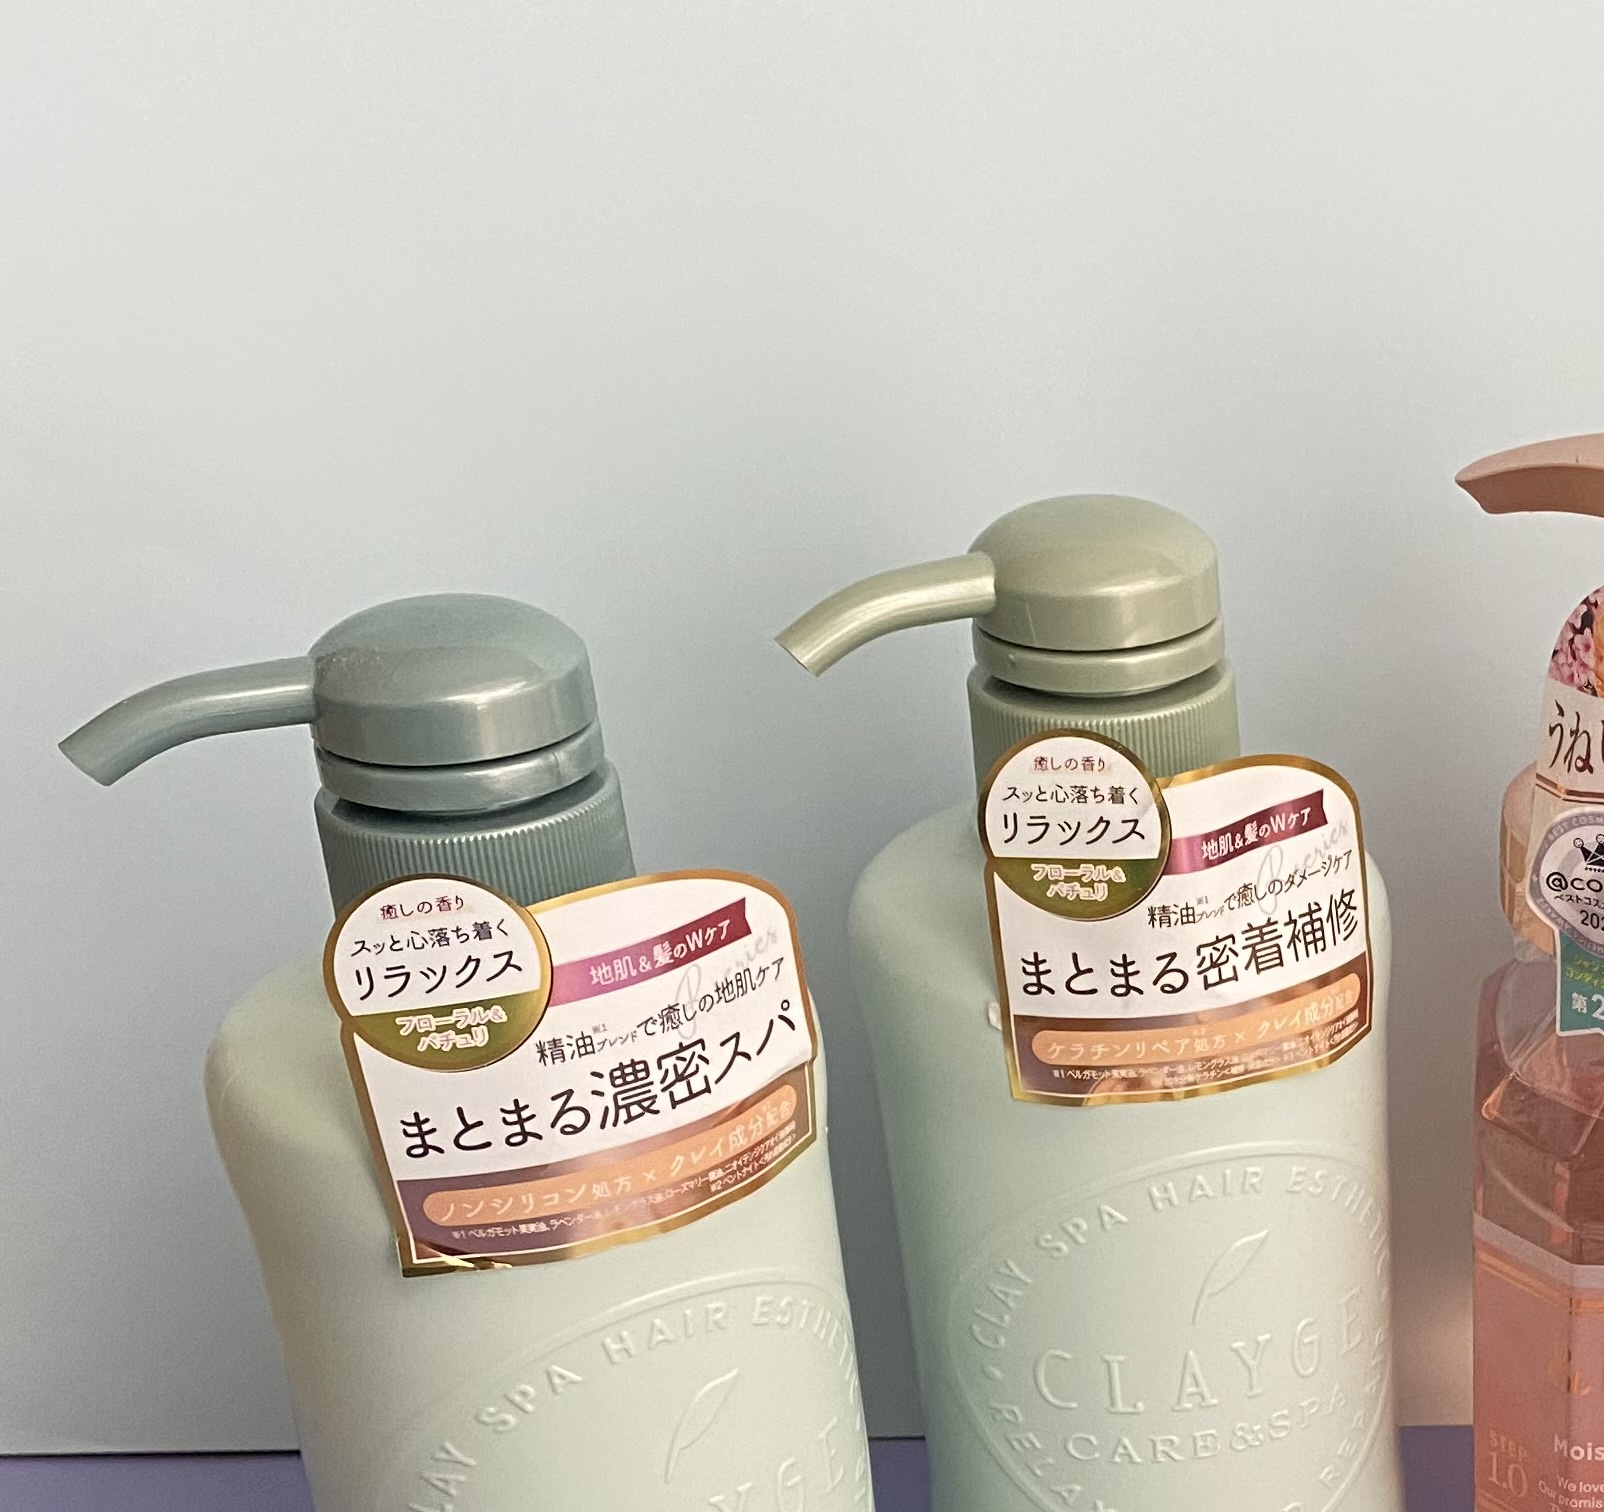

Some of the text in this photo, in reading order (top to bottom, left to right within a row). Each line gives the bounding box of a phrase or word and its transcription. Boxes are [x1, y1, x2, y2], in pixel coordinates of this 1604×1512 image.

[1034, 756, 1106, 773] 癒しの香り
[1003, 785, 1139, 805] スッと心落ち着く
[1002, 813, 1146, 847] リラックス
[1200, 806, 1312, 861] 地肌&髪のWケア
[1032, 863, 1127, 883] フローラル&
[1047, 881, 1109, 902] パチュリ
[380, 894, 466, 919] 癒しの香り
[350, 920, 509, 957] スッと心落ち着く
[590, 920, 731, 986] 地肌&髪のWケア
[1020, 887, 1359, 998] まとまる密着補修
[355, 951, 523, 1001] リラックス
[396, 1005, 507, 1036] フローラル&
[417, 1026, 490, 1052] パチュリ
[399, 1000, 797, 1159] まとまる濃密スパ
[440, 1175, 633, 1223] ノンシリコン処方
[1035, 1166, 1264, 1258] SPA HAIR
[474, 1301, 730, 1433] SPA HAIR
[1034, 1285, 1363, 1414] CLAYGE
